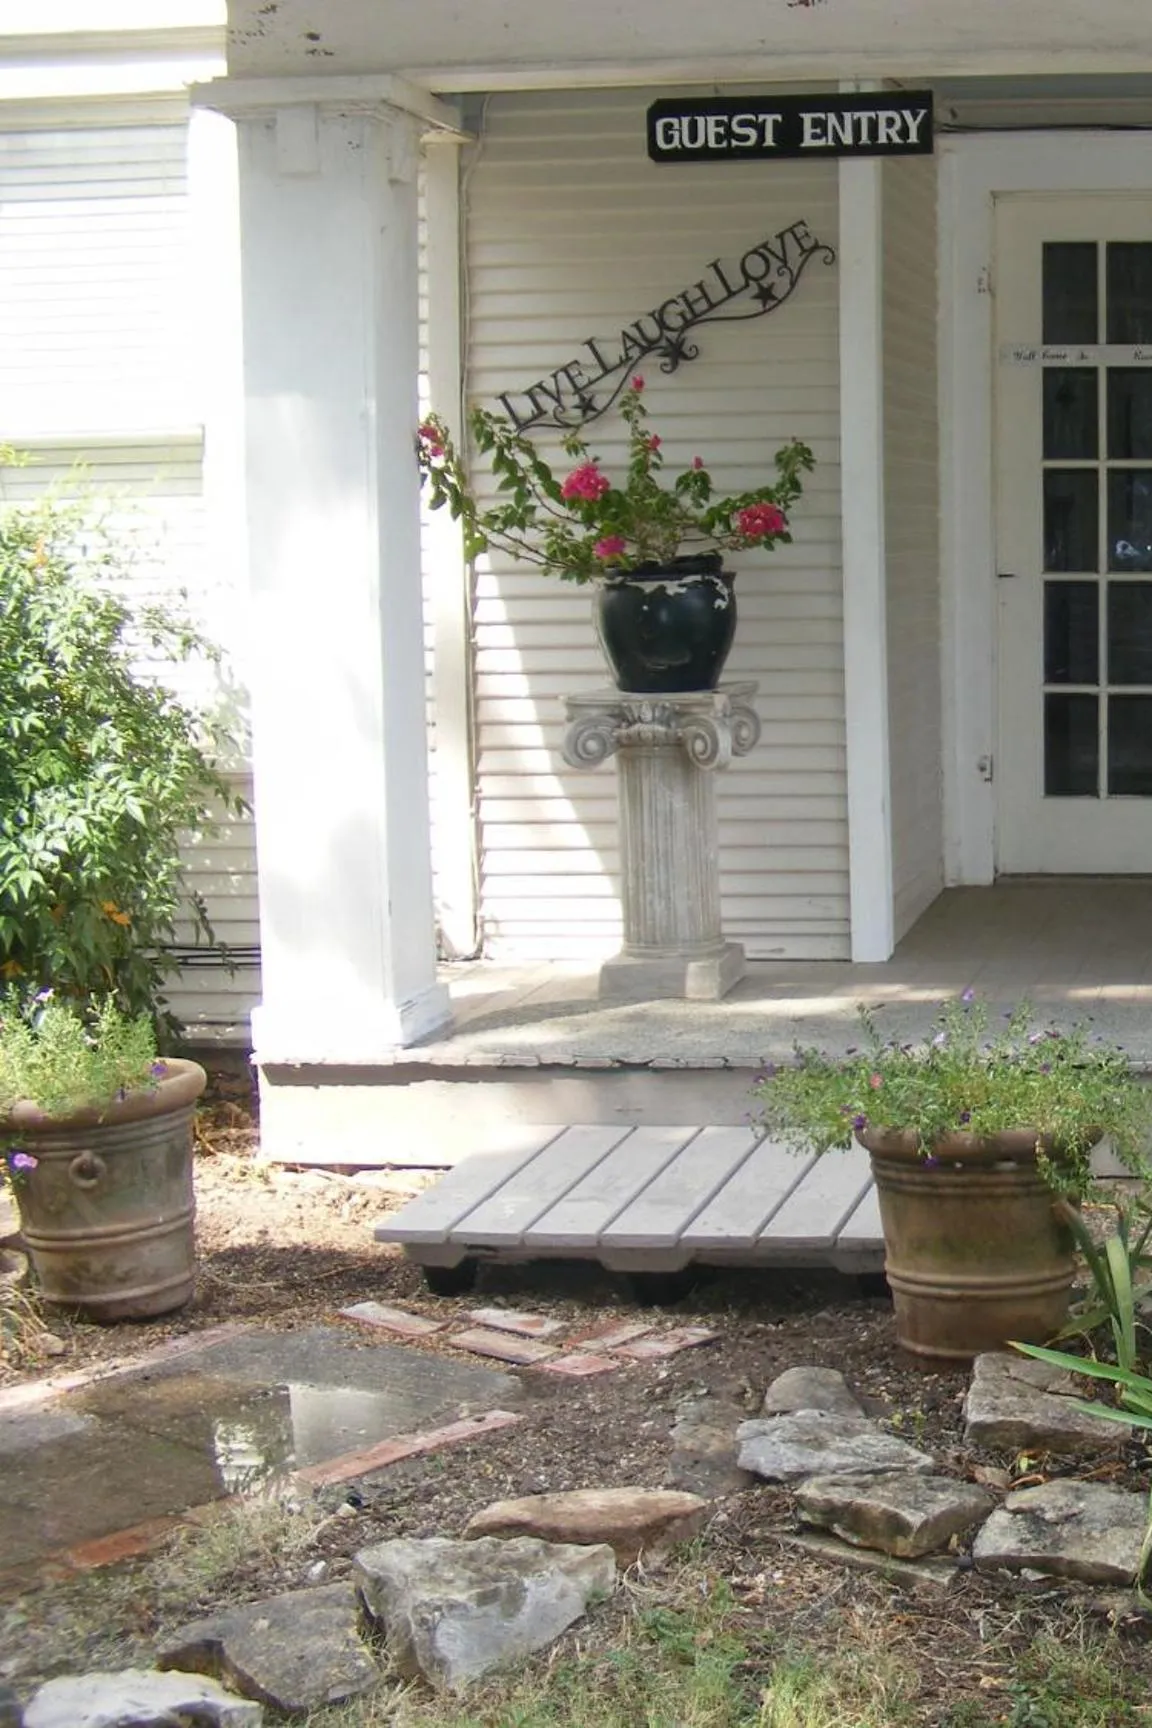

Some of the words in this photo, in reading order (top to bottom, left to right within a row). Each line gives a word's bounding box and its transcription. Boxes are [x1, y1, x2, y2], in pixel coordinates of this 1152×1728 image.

[655, 113, 782, 150] GUEST
[800, 109, 928, 147] ENTRY
[498, 360, 597, 430] LIVE
[583, 280, 715, 375] LAUGH
[707, 220, 820, 299] LOVE
